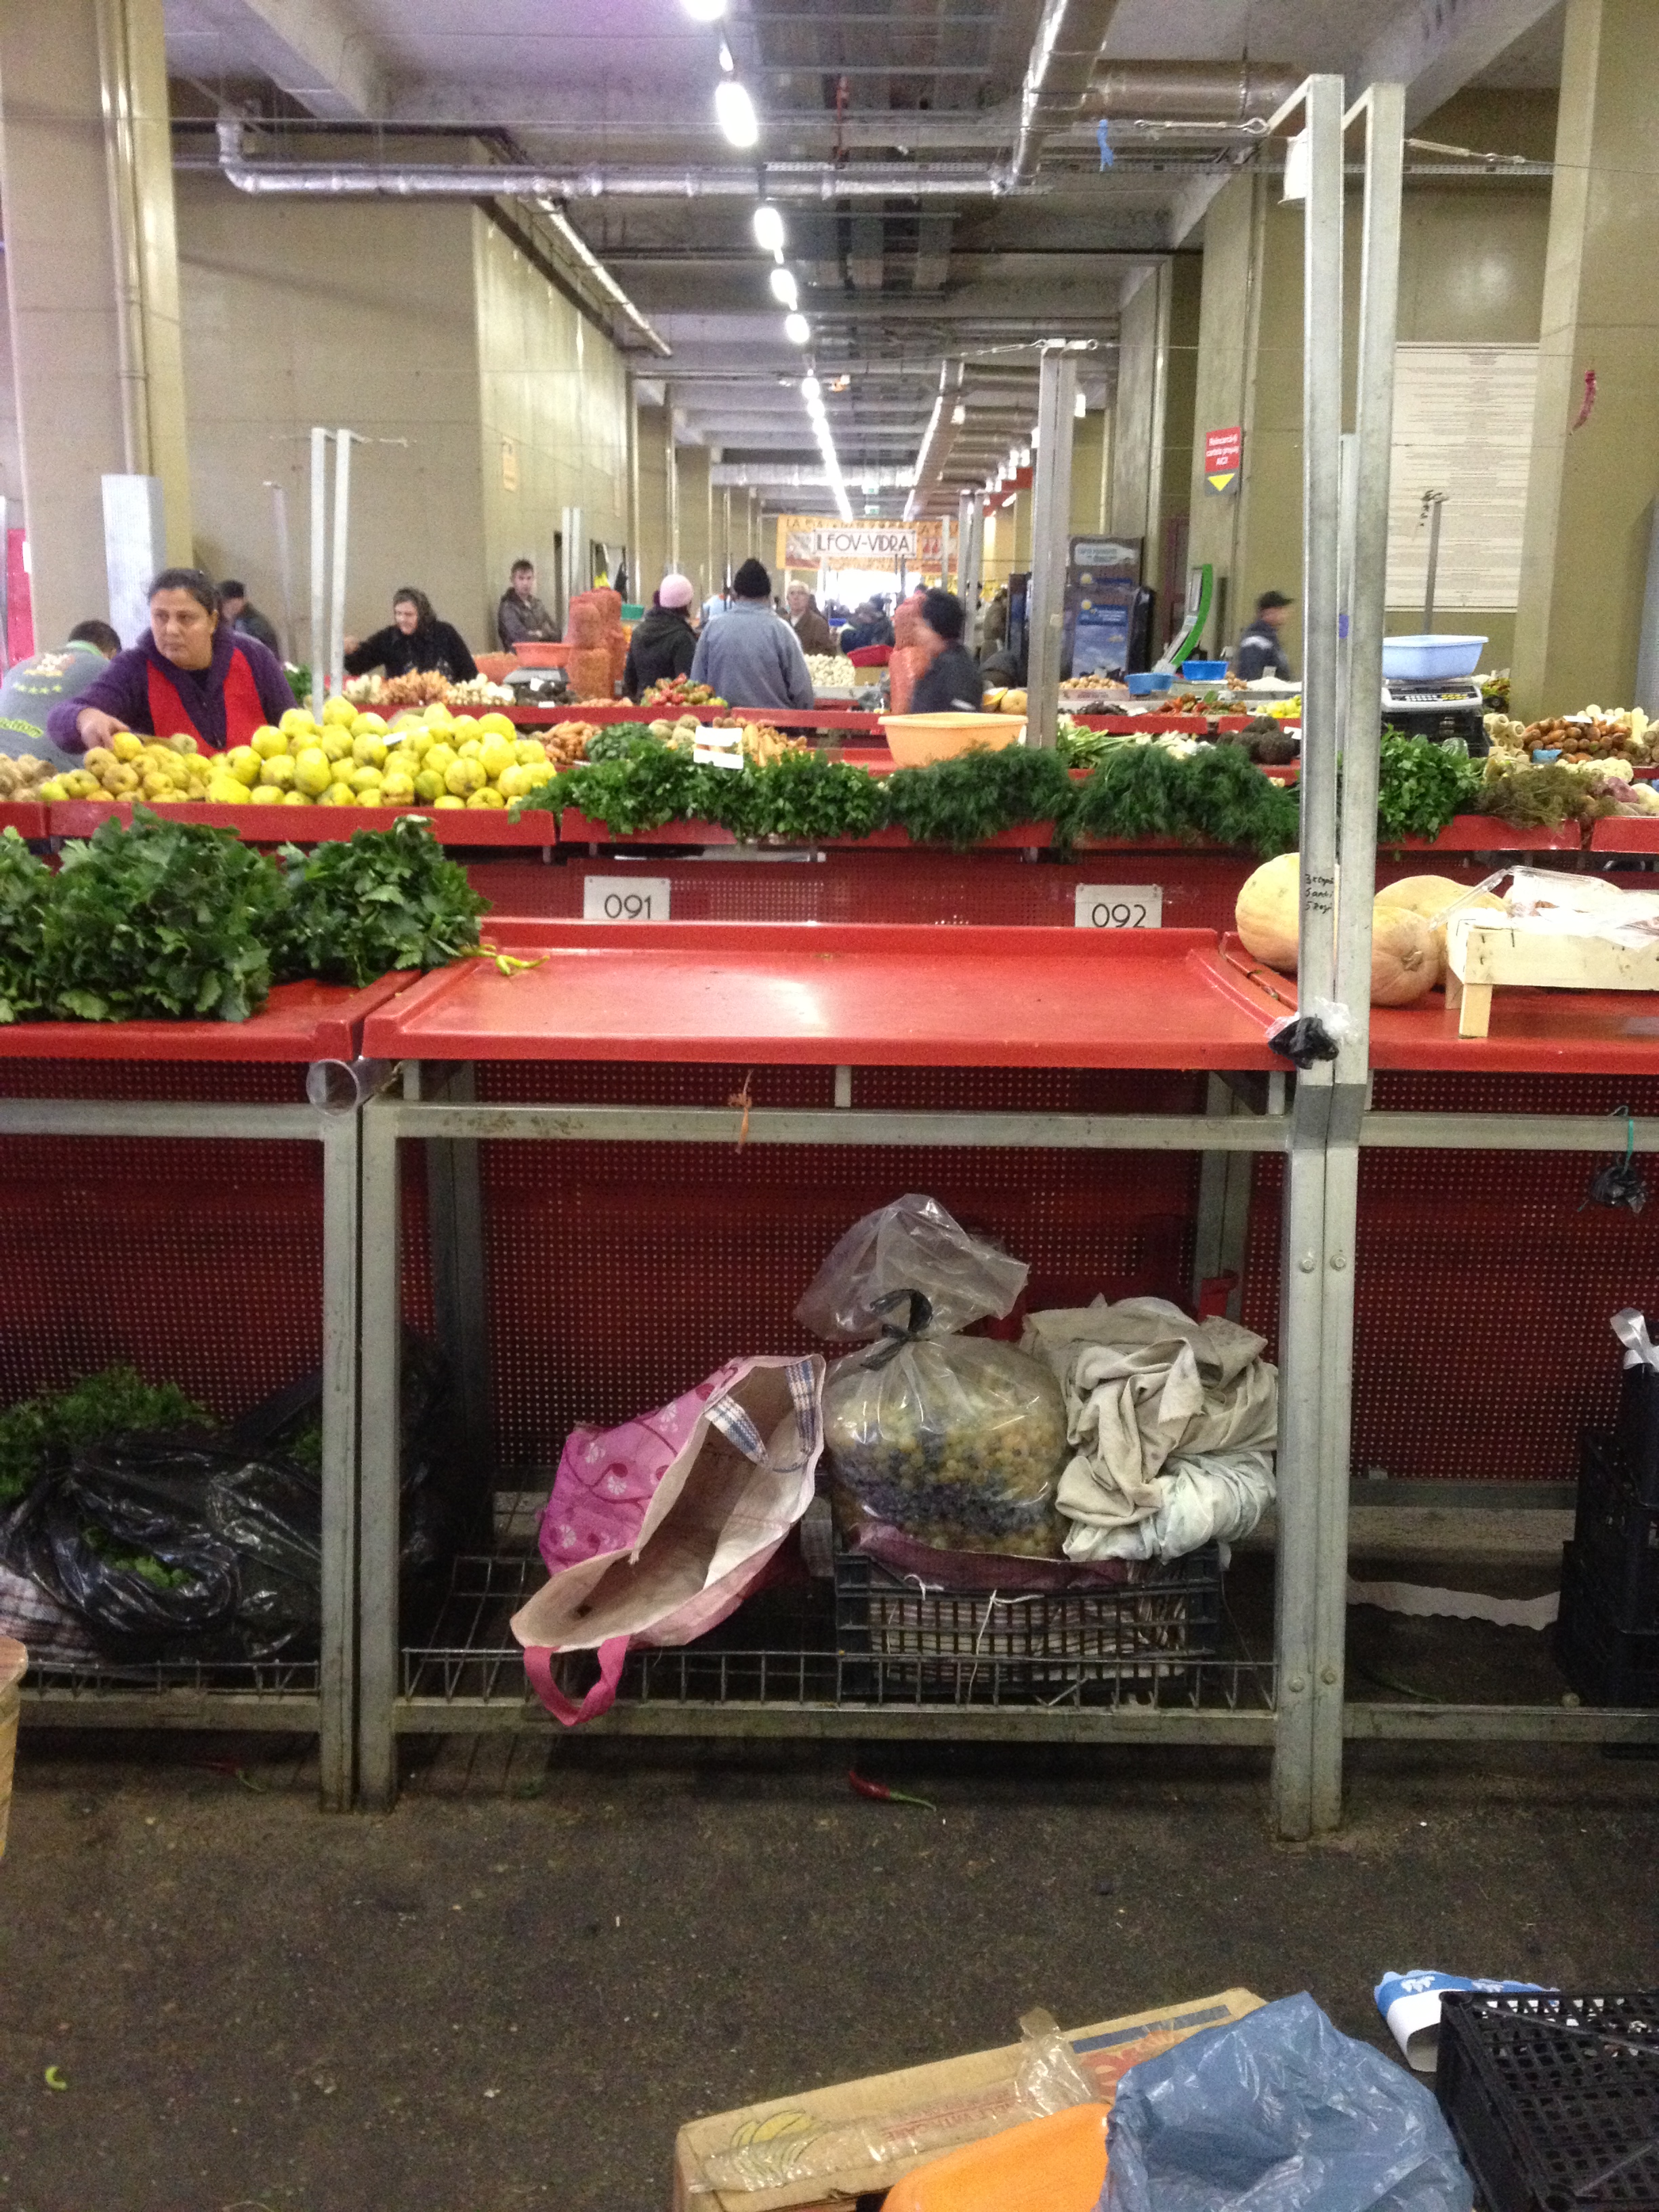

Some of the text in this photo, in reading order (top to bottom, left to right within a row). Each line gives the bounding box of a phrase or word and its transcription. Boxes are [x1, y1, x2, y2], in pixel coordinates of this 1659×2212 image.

[817, 534, 910, 552] ILFOV-VIDRA
[605, 894, 651, 919] 091
[1092, 903, 1147, 928] 092
